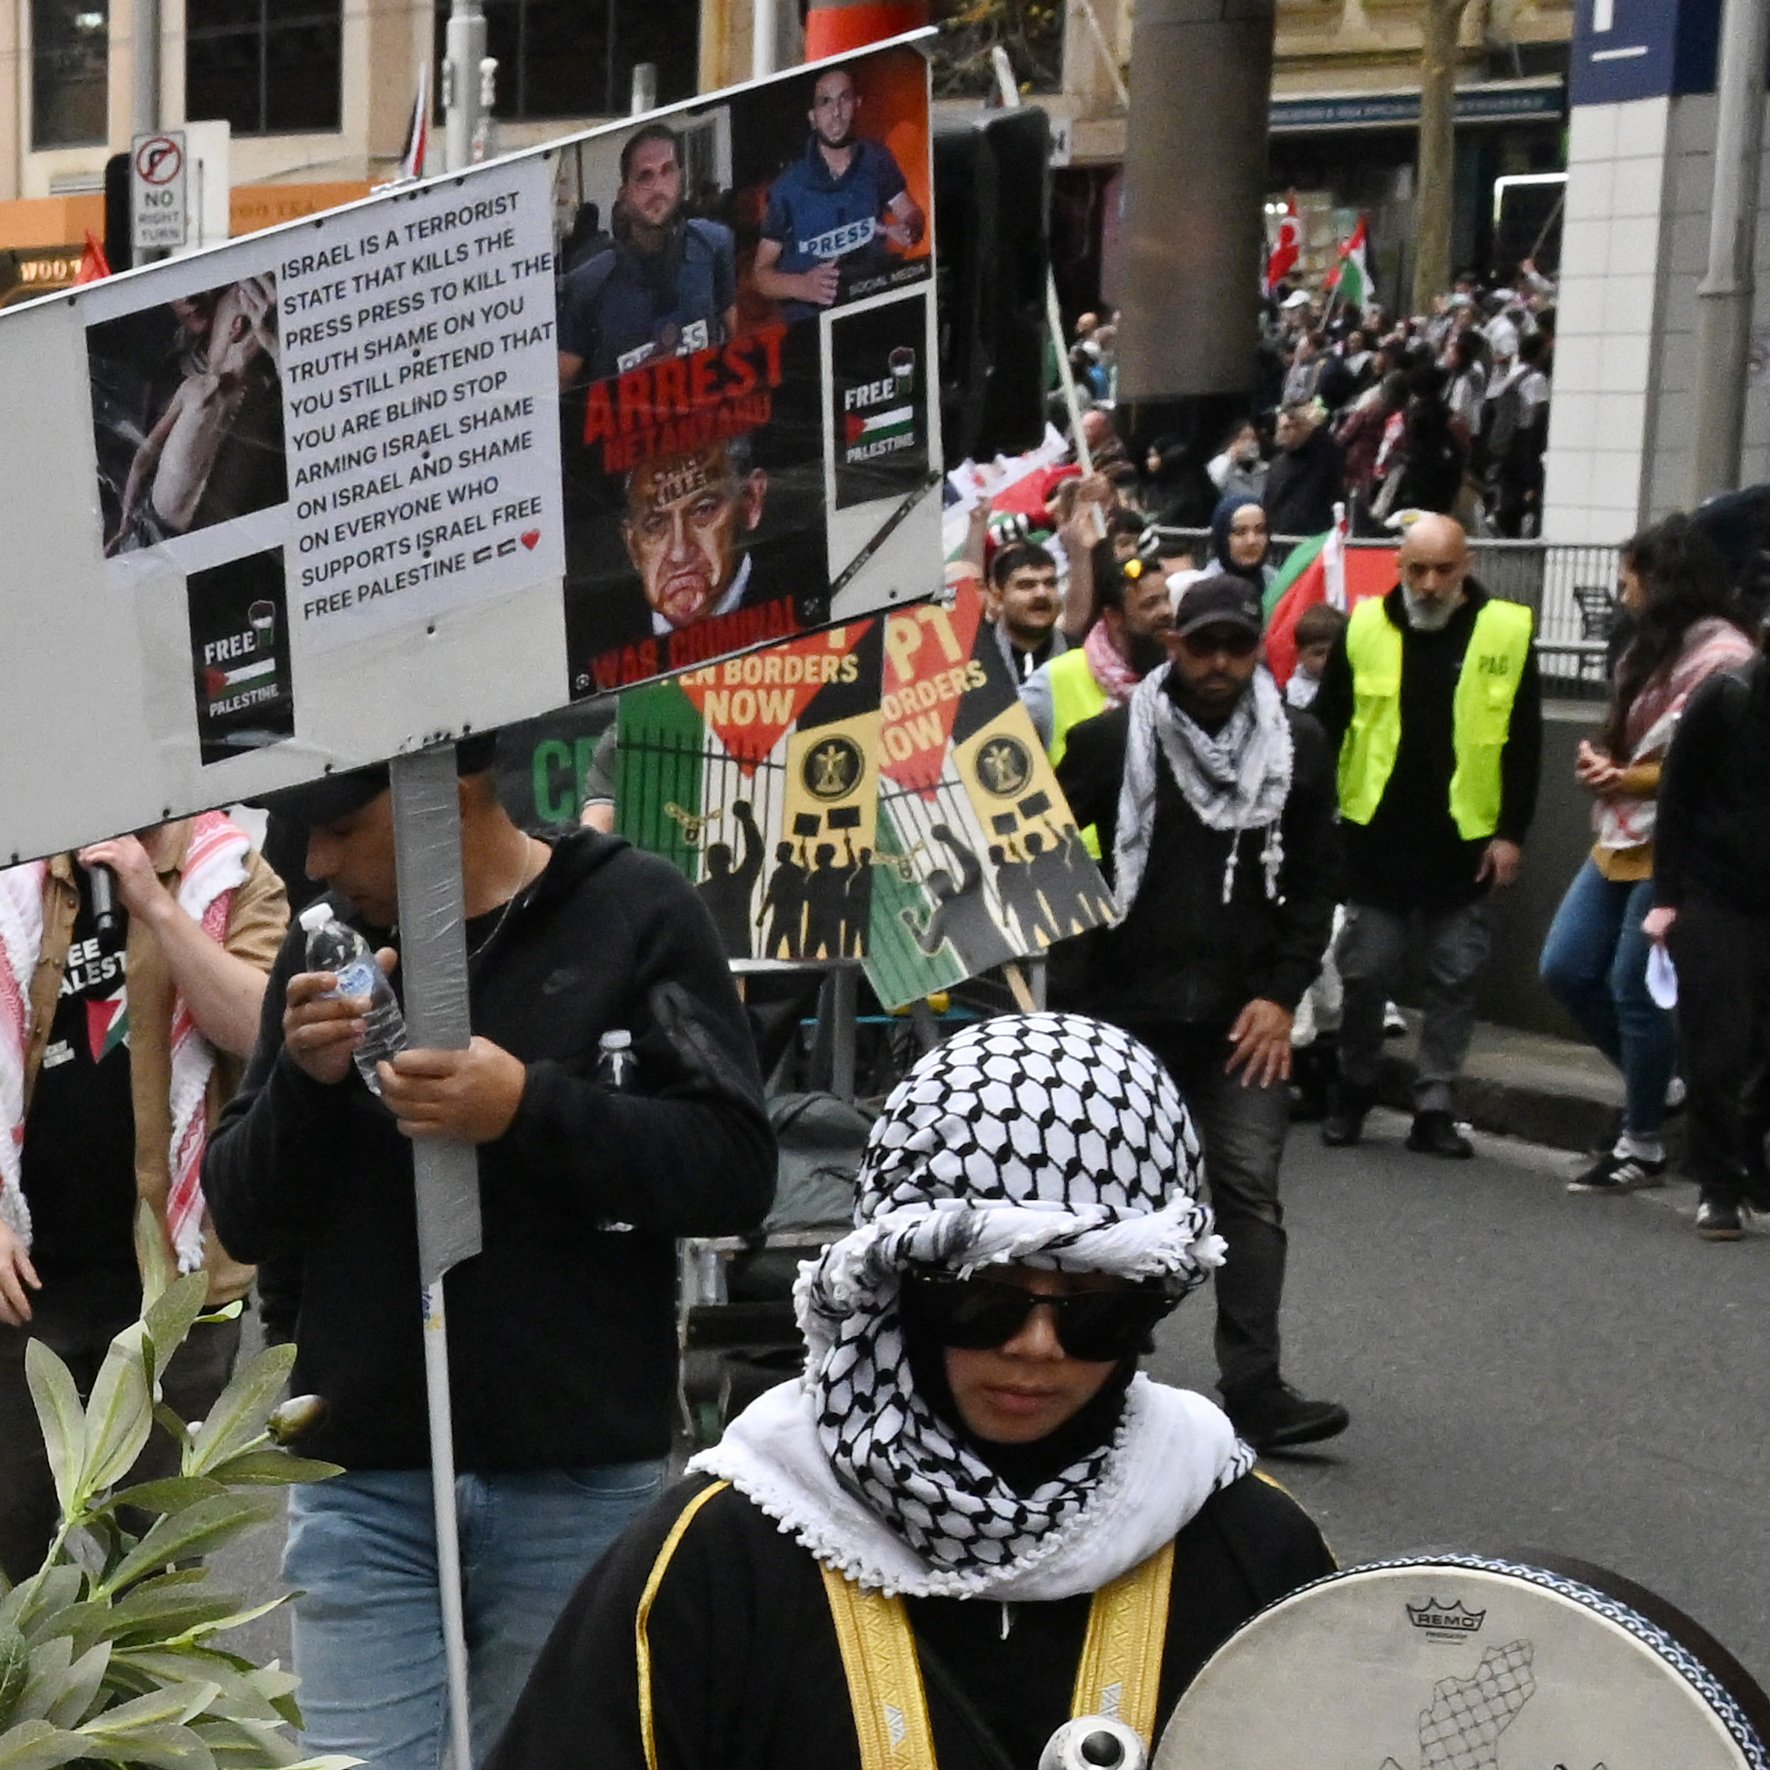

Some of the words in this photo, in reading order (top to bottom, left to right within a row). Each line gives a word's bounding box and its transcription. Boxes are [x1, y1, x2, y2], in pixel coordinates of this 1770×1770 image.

[138, 211, 179, 224] RIGHT
[145, 190, 174, 208] NO
[141, 228, 179, 241] TURN
[281, 243, 355, 281] ISRAEL
[360, 232, 380, 257] IS
[385, 229, 400, 250] A
[403, 191, 520, 243] TERRORIST
[807, 220, 871, 254] PRESS
[284, 280, 348, 316] STATE
[351, 260, 407, 295] THAT
[412, 243, 470, 276] KILLS
[474, 228, 516, 256] THE
[286, 314, 353, 351] PRESS
[358, 291, 426, 327] PRESS
[430, 281, 459, 305] TO
[463, 268, 507, 297] KILL
[512, 251, 553, 280] THE
[287, 347, 360, 384] TRUTH
[364, 321, 439, 360] SHAME
[443, 310, 476, 336] ON
[480, 295, 525, 325] YOU
[290, 389, 334, 418] YOU
[339, 372, 394, 404] STILL
[399, 340, 494, 385] PRETEND
[500, 320, 555, 354] THAT
[293, 423, 336, 452] YOU
[341, 408, 382, 438] ARE
[386, 388, 448, 424] BLIND
[453, 370, 508, 402] STOP
[583, 325, 789, 445] ARREST
[844, 377, 896, 411] FREE
[295, 446, 377, 488] ARMING
[382, 422, 454, 459] ISRAEL
[459, 396, 535, 435] SHAME
[297, 496, 328, 521] ON
[332, 472, 404, 510] ISRAEL
[409, 456, 453, 484] AND
[459, 431, 533, 469] SHAME
[299, 528, 329, 554] ON
[335, 493, 443, 543] EVERYONE
[447, 475, 499, 506] WHO
[301, 536, 411, 588] SUPPORTS
[416, 514, 487, 551] ISRAEL
[492, 495, 543, 527] FREE
[304, 590, 353, 621] FREE
[358, 552, 466, 603] PALESTINE
[204, 630, 256, 666] FREE
[723, 653, 859, 687] BORDERS
[209, 683, 280, 718] PALESTINE
[702, 690, 798, 727] NOW
[882, 658, 988, 722] ORDERS
[1417, 1613, 1475, 1628] REMO
